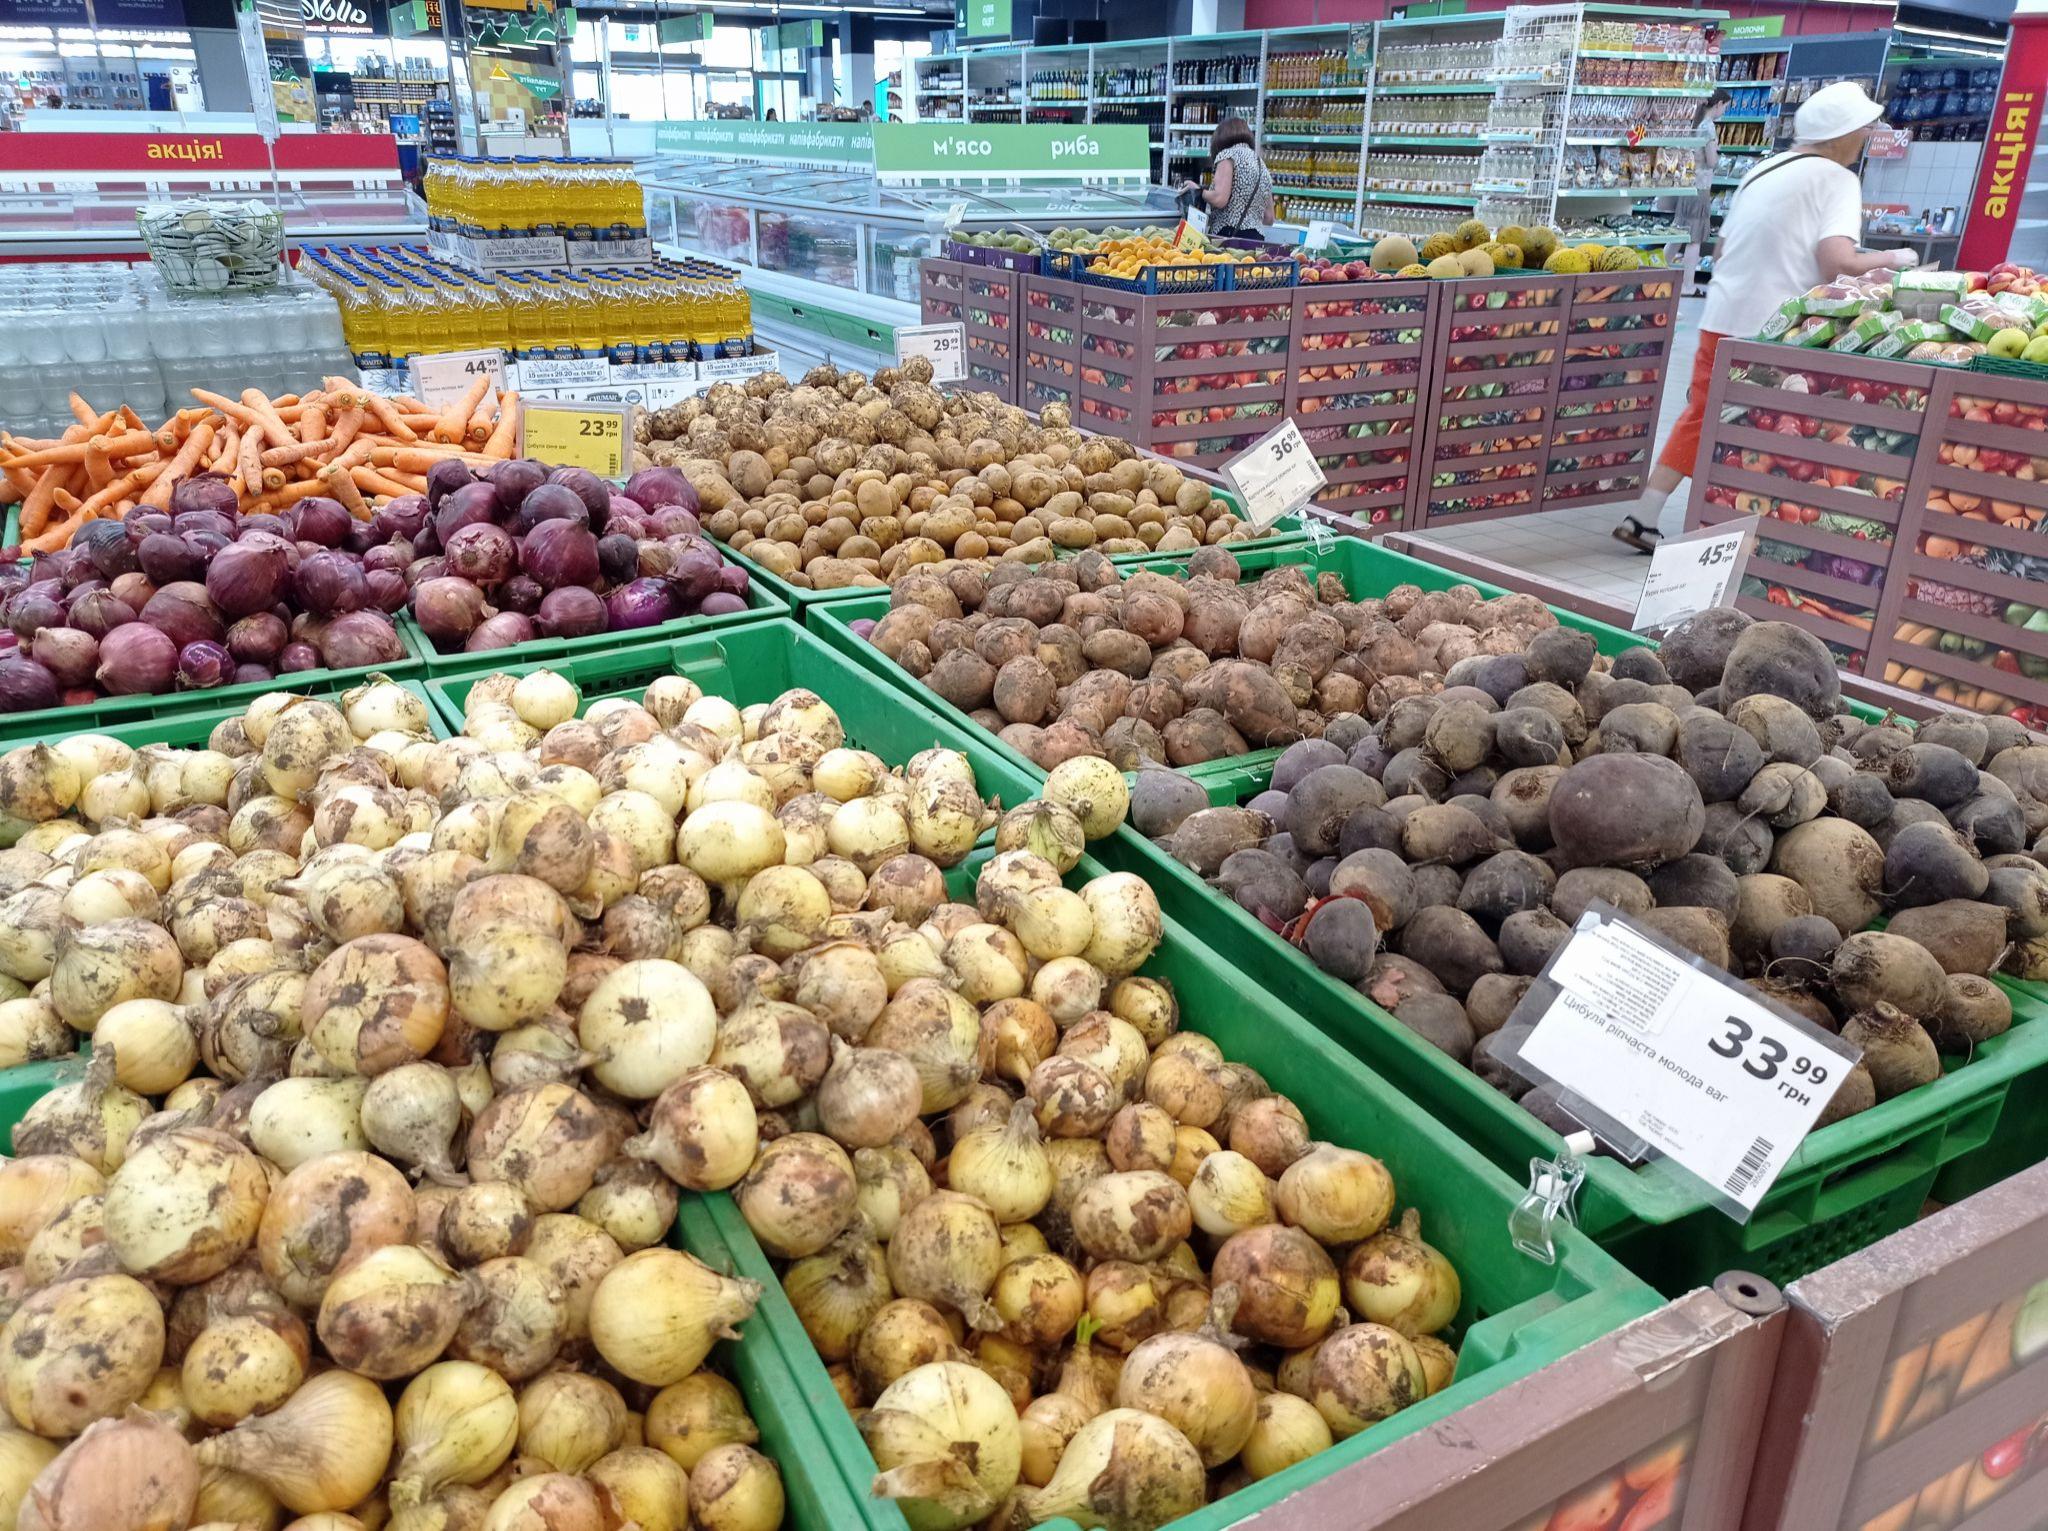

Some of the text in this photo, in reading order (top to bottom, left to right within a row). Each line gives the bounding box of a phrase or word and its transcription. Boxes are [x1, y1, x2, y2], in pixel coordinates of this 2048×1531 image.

[147, 138, 224, 163] акція!
[738, 128, 785, 147] напівфабрикати
[789, 130, 844, 149] напівфабрикати
[933, 134, 1099, 160] м'ясо риба
[1984, 92, 2034, 219] акція!
[933, 338, 950, 351] 29
[465, 358, 498, 375] 44 99
[488, 366, 499, 374] грн
[579, 419, 618, 437] 23 99
[1271, 438, 1293, 461] 36
[1287, 430, 1297, 441] 99
[1698, 540, 1738, 566] 45 99
[1722, 555, 1733, 563] грн
[1563, 995, 1729, 1104] Цибуля ріпчаста молода ваг
[1708, 1015, 1829, 1086] 33 99
[1777, 1080, 1812, 1107] грн
